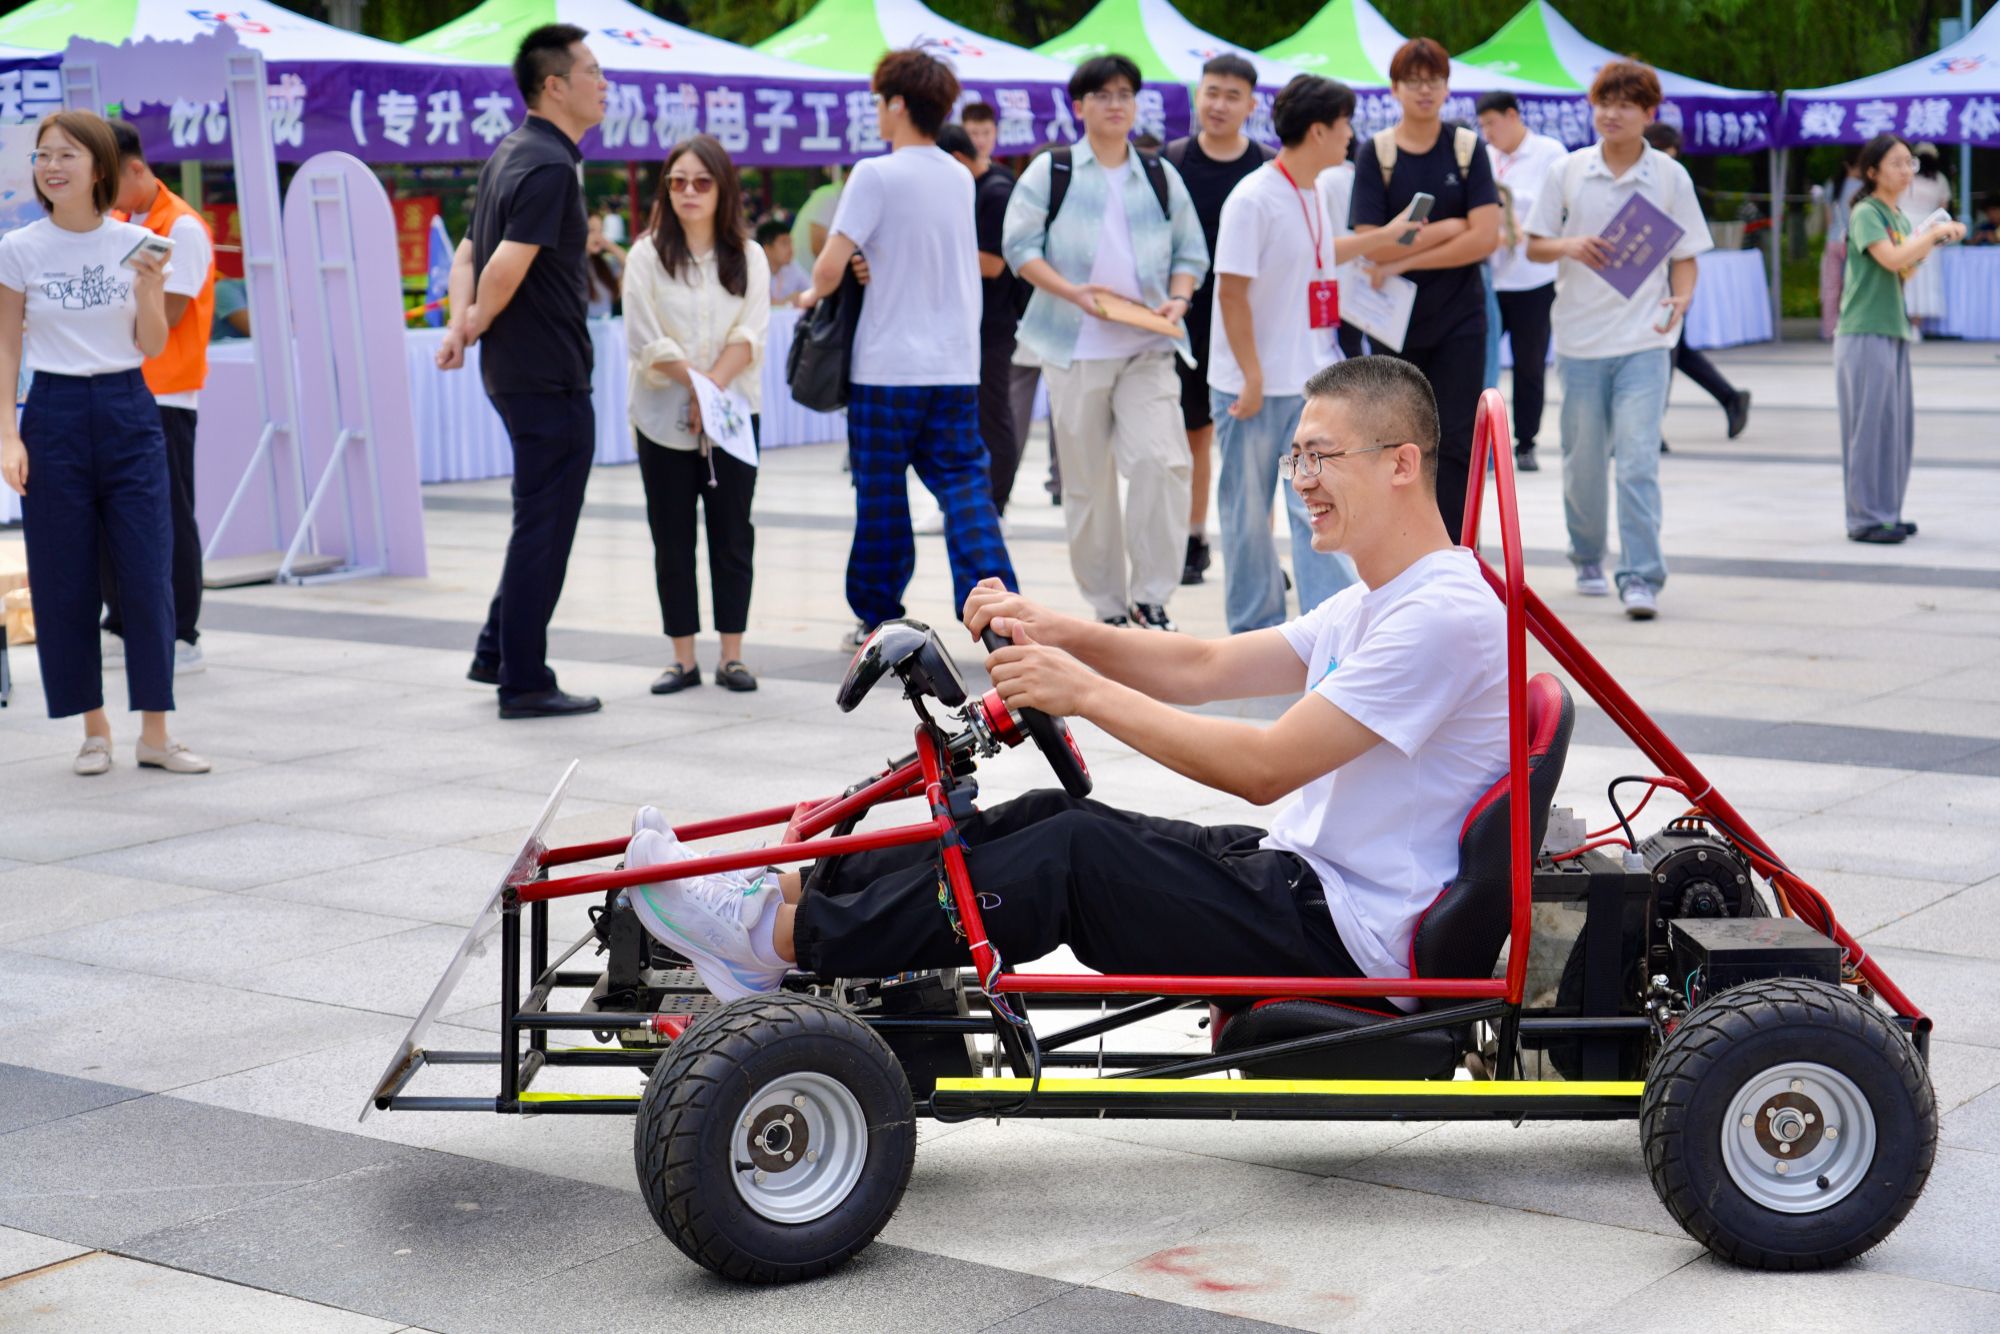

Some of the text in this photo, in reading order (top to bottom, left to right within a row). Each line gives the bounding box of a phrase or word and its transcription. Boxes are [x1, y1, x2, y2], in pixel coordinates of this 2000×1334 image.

[600, 79, 888, 153] 机械电子工程
